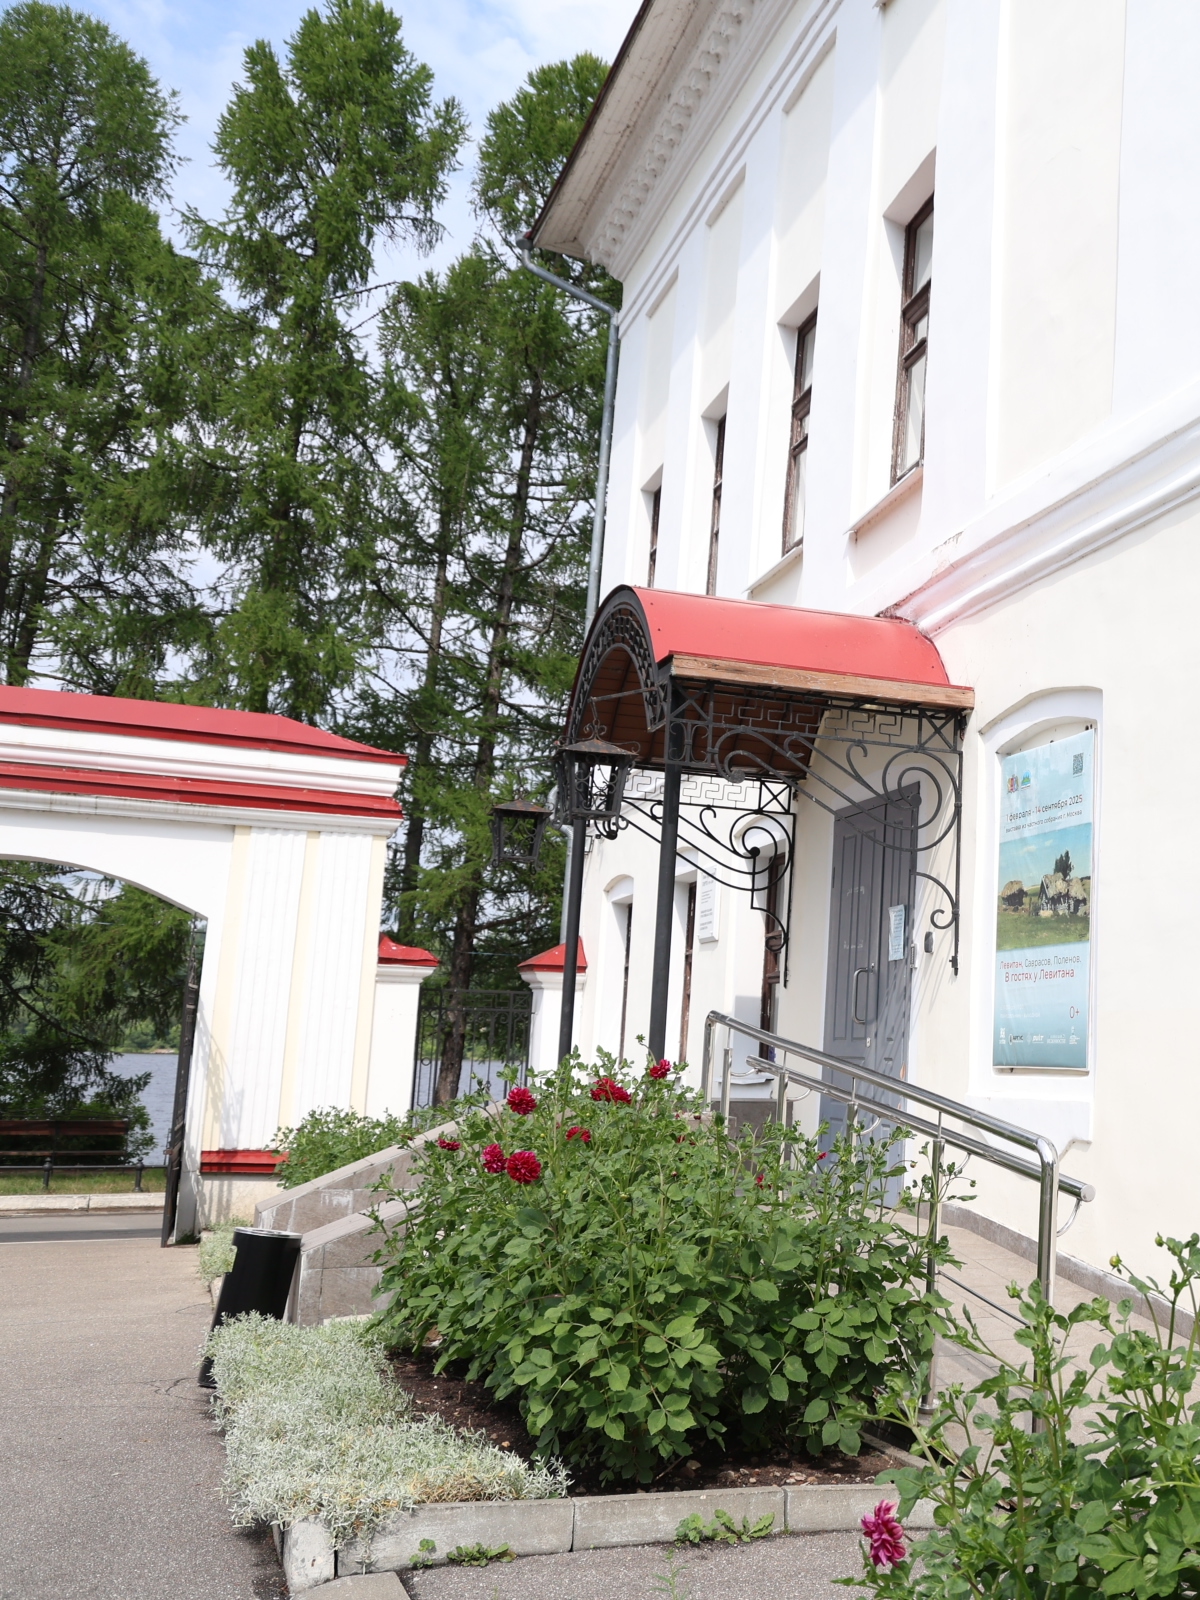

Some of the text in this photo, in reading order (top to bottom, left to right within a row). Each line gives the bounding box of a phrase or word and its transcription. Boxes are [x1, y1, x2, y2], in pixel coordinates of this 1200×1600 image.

[1035, 806, 1041, 815] 14
[1041, 799, 1068, 813] сентября
[1068, 794, 1083, 806] 2025
[1066, 809, 1082, 818] Москва
[1005, 968, 1075, 983] В гостях у Левитана
[1069, 1005, 1080, 1019] 0+
